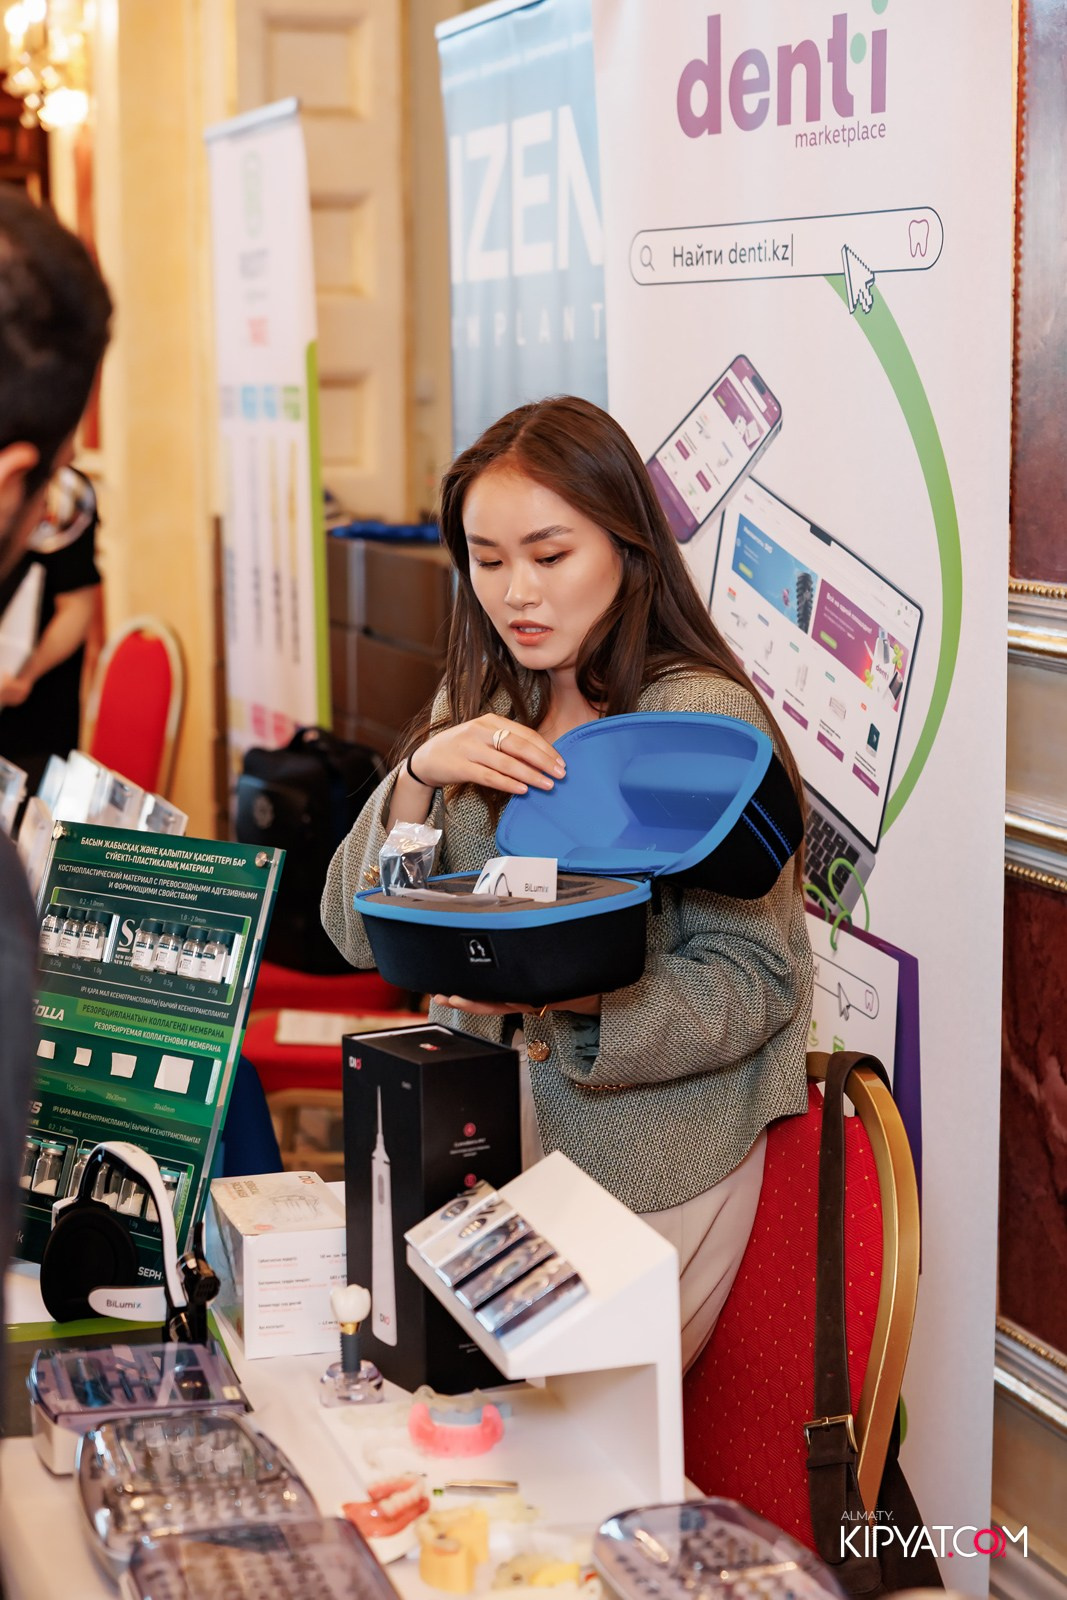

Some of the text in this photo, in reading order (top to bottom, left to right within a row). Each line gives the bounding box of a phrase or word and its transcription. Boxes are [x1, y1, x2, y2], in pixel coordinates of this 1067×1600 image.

[677, 0, 888, 139] denti
[795, 121, 886, 148] marketplace
[673, 238, 789, 267] Найти denti.kz
[81, 837, 103, 847] БАСЫМ
[104, 840, 139, 854] ЖАБЫСҚАҚ
[139, 845, 158, 855] ЖӘНЕ
[159, 848, 193, 860] ҚАЛЫПТАУ
[232, 858, 247, 867] БАР
[58, 863, 258, 901] КОСТНОПЛАСТИЧЕСКИЙ МАТЕРИАЛ С ПРЕВОСХОДНЫМИ АДГЕЗИВНЫМИ
[180, 863, 214, 875] МАТЕРИАЛ
[108, 881, 198, 902] И ФОРМУЮЩИМИ СВОЙСТВАМИ
[82, 1004, 224, 1038] РЕЗОРБЦИЯЛАНАТЫН КОЛЛАГЕНДІ МЕМБРАНА
[94, 1021, 221, 1052] РЕЗОРБИРУЕМАЯ КОЛЛАГЕНОВАЯ МЕМБРАНА
[106, 1299, 141, 1309] BiLumix
